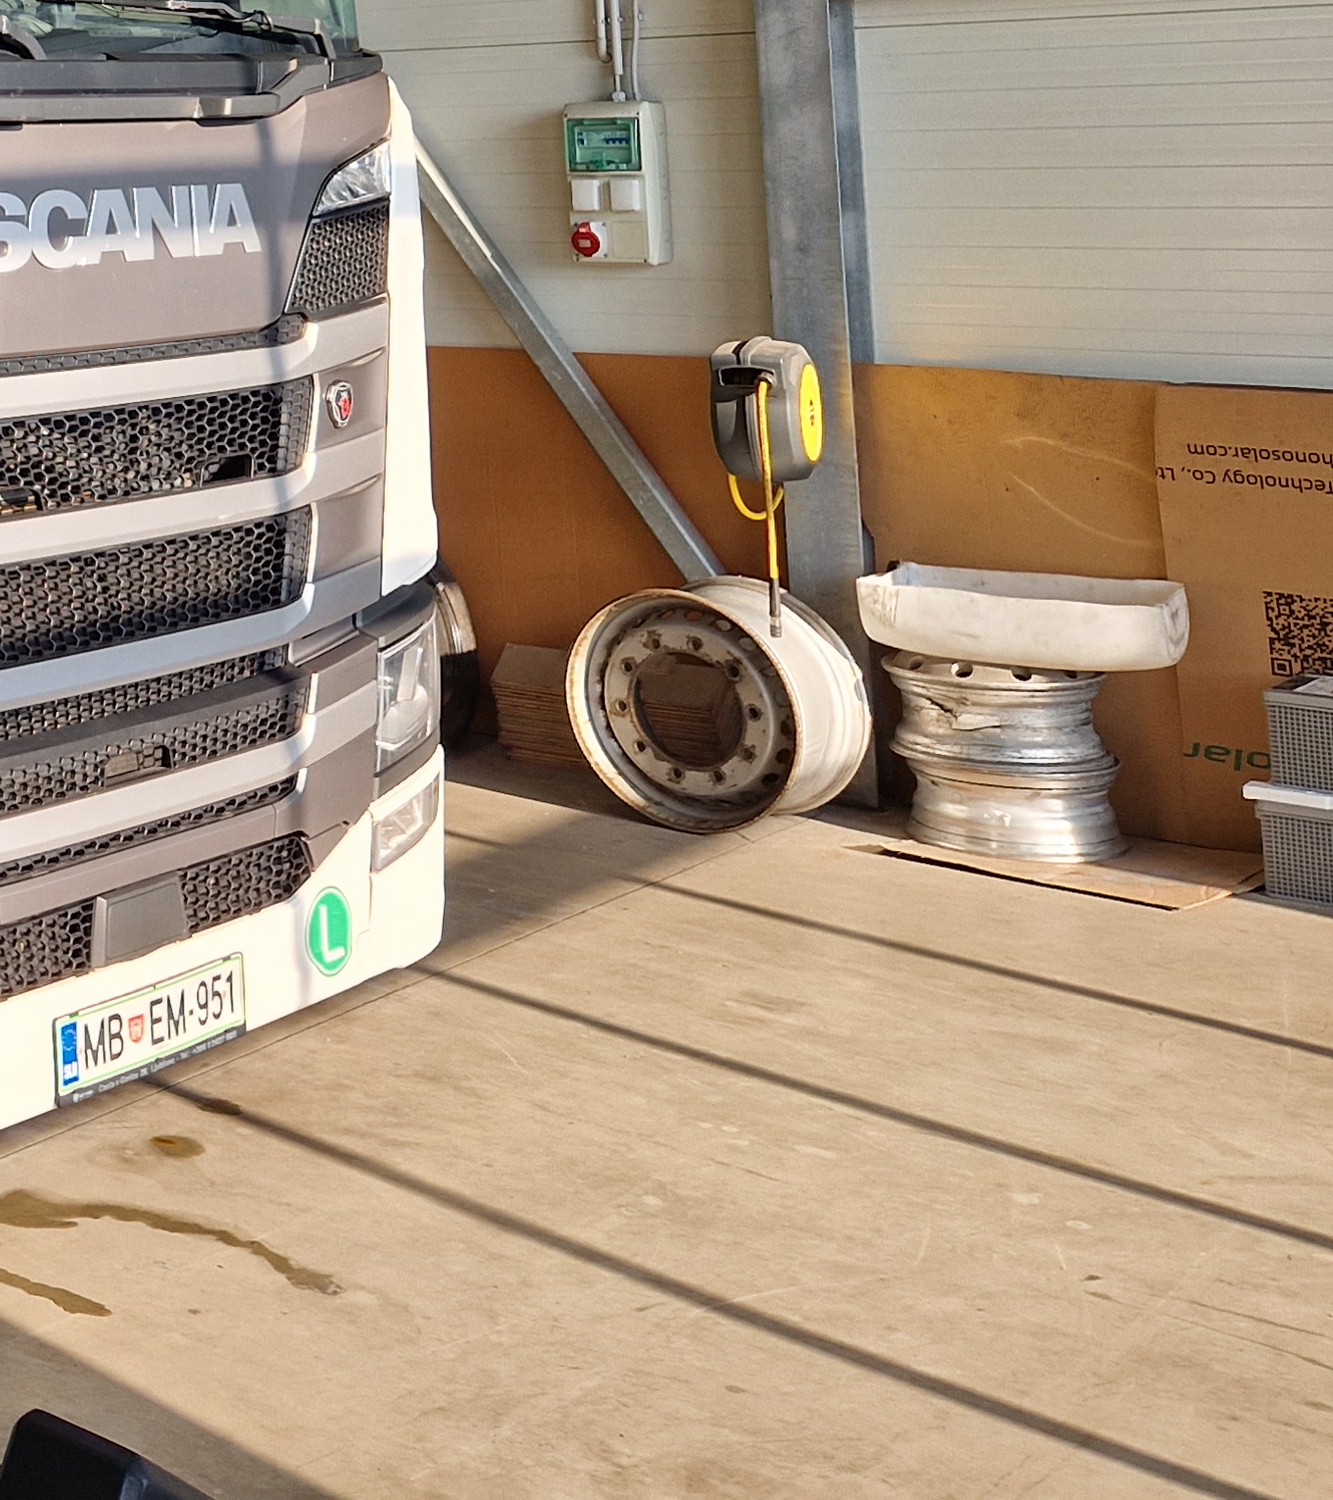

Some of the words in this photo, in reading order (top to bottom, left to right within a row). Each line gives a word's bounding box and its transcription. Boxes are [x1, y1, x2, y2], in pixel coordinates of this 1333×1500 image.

[1181, 466, 1216, 485] Co.,
[1222, 468, 1333, 496] Technology
[317, 905, 347, 964] L
[83, 1009, 125, 1071] MB
[149, 972, 237, 1046] EM-951
